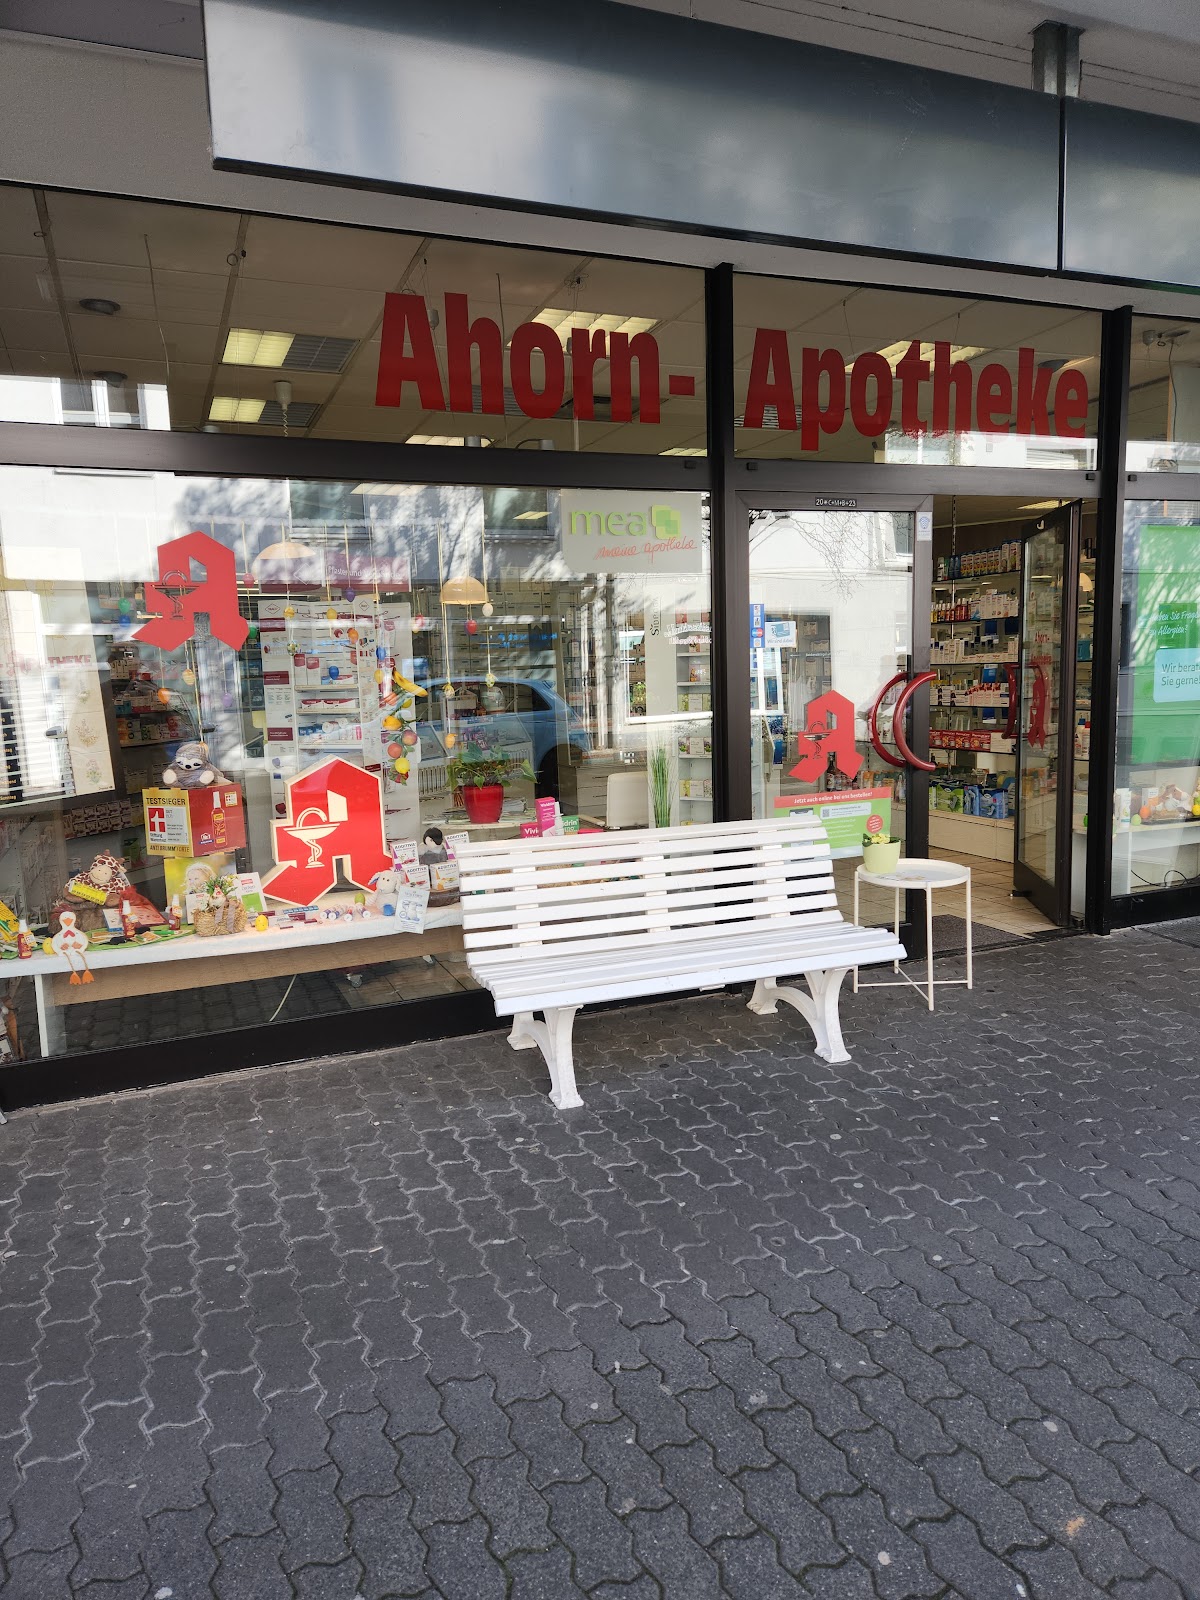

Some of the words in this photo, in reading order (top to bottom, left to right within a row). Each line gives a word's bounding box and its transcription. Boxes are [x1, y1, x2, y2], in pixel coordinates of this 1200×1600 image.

[375, 292, 696, 424] Ahorn-
[743, 328, 1089, 451] Apotheke
[571, 510, 647, 536] mea
[1162, 663, 1176, 673] Wir
[1162, 675, 1173, 686] Sie
[146, 797, 186, 806] TESTSIEGER
[524, 827, 538, 835] Vivi
